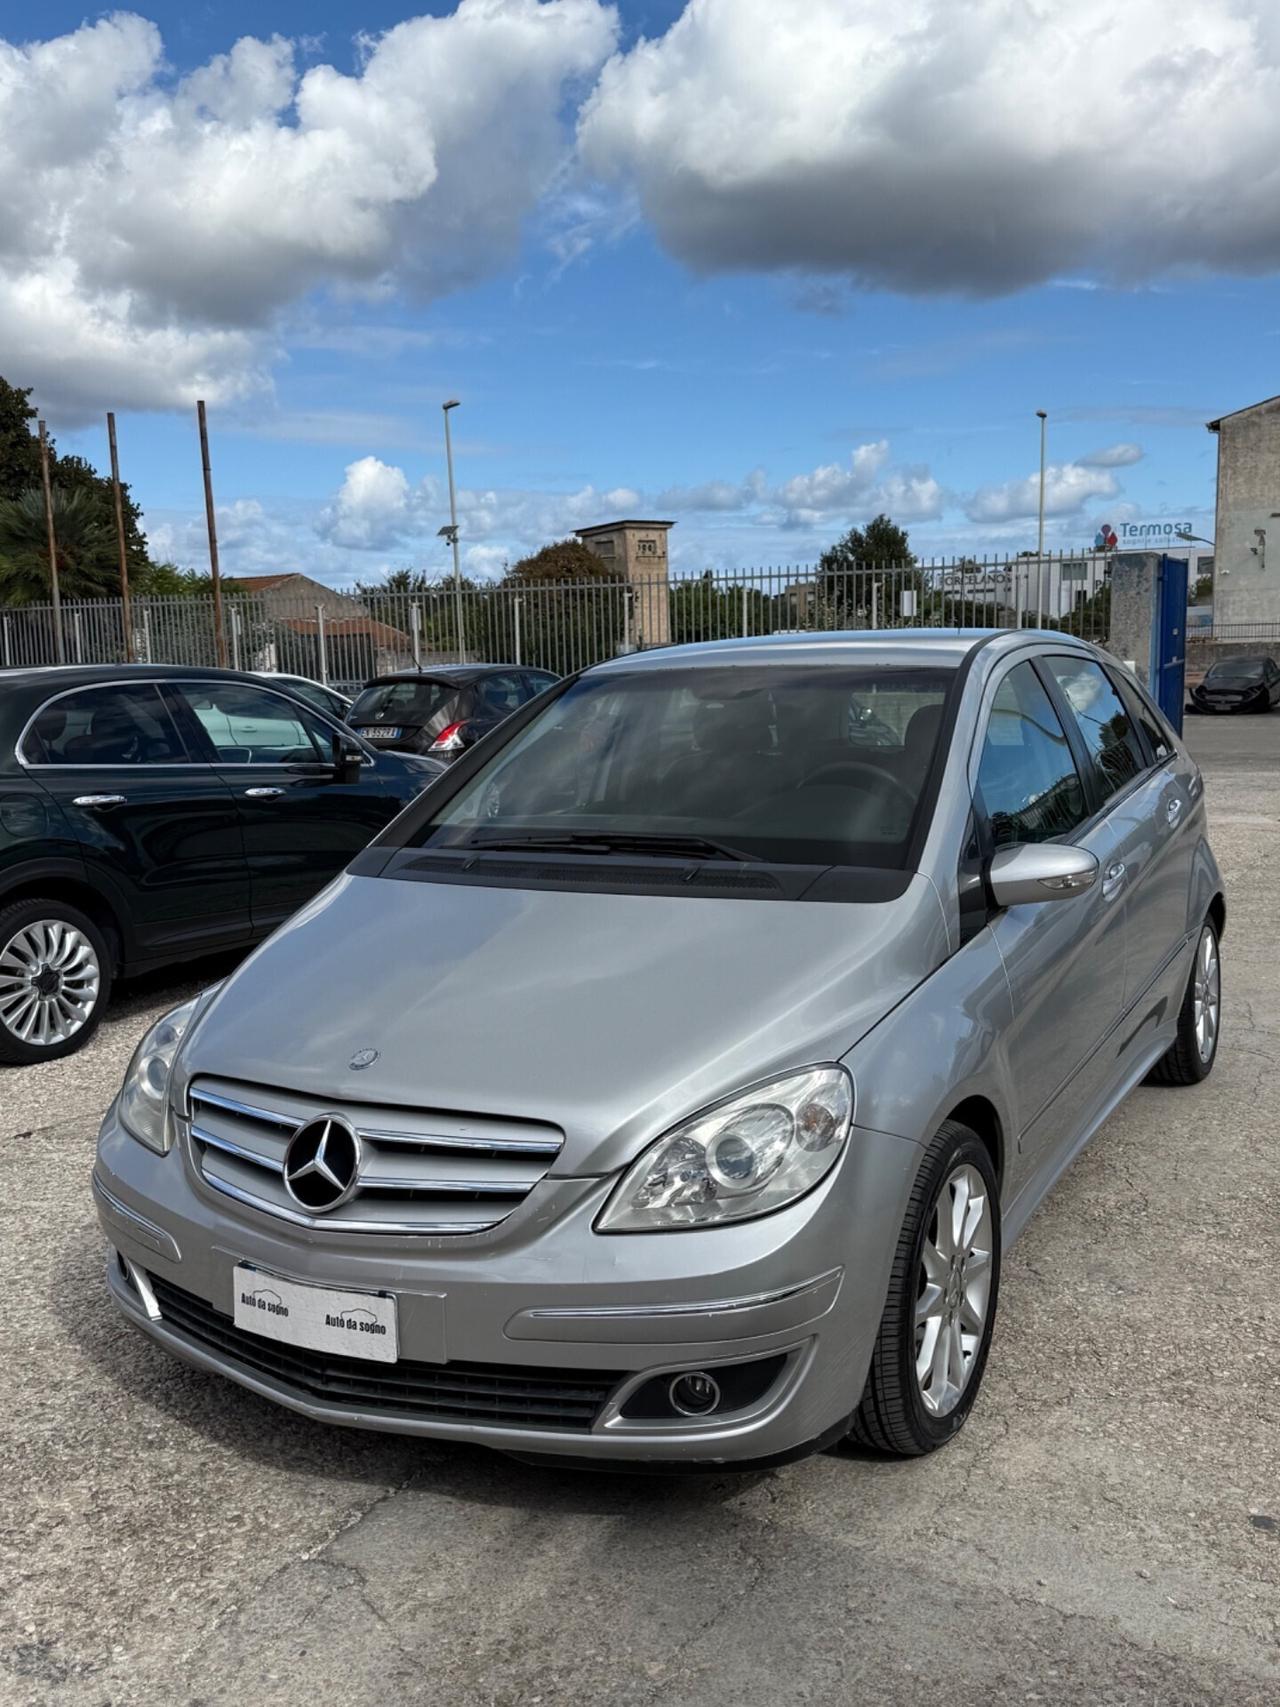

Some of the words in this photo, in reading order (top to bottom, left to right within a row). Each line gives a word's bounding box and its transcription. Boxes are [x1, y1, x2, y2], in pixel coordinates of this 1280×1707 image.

[1120, 522, 1192, 537] Termosa
[241, 1292, 256, 1307] Auto
[257, 1298, 266, 1310] da
[267, 1302, 289, 1317] sogno
[325, 1314, 345, 1328] Auto
[346, 1318, 357, 1330] da
[359, 1321, 386, 1335] sogno
